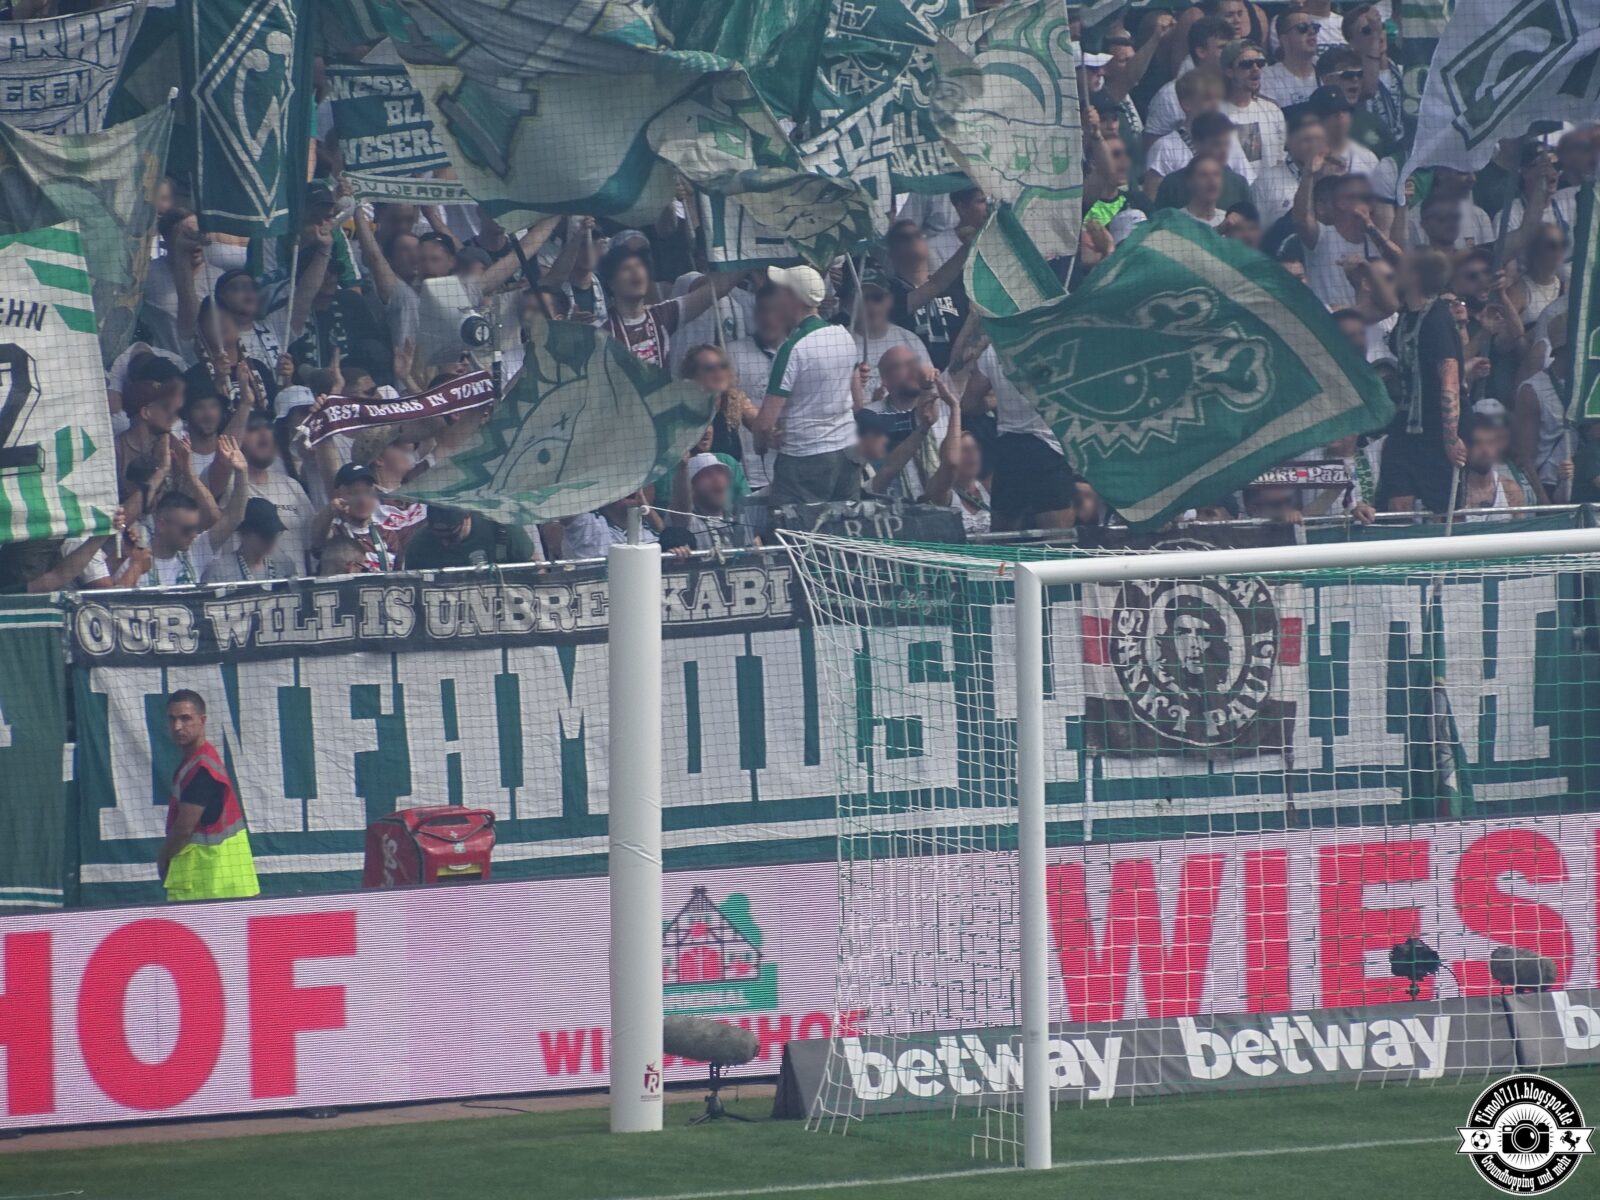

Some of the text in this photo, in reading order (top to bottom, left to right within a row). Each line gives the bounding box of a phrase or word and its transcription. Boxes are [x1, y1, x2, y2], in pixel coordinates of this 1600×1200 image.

[0, 298, 47, 331] HN
[323, 404, 361, 422] BEST
[426, 393, 448, 407] IN
[76, 602, 198, 655] OUR
[205, 588, 355, 651] WILL
[359, 586, 417, 639] IS
[423, 564, 793, 640] UNBREKAB
[90, 573, 1557, 840] INFAMOUS YTH
[1046, 824, 1600, 1023] WIES
[841, 1034, 1123, 1101] betway
[1178, 1015, 1451, 1080] betway
